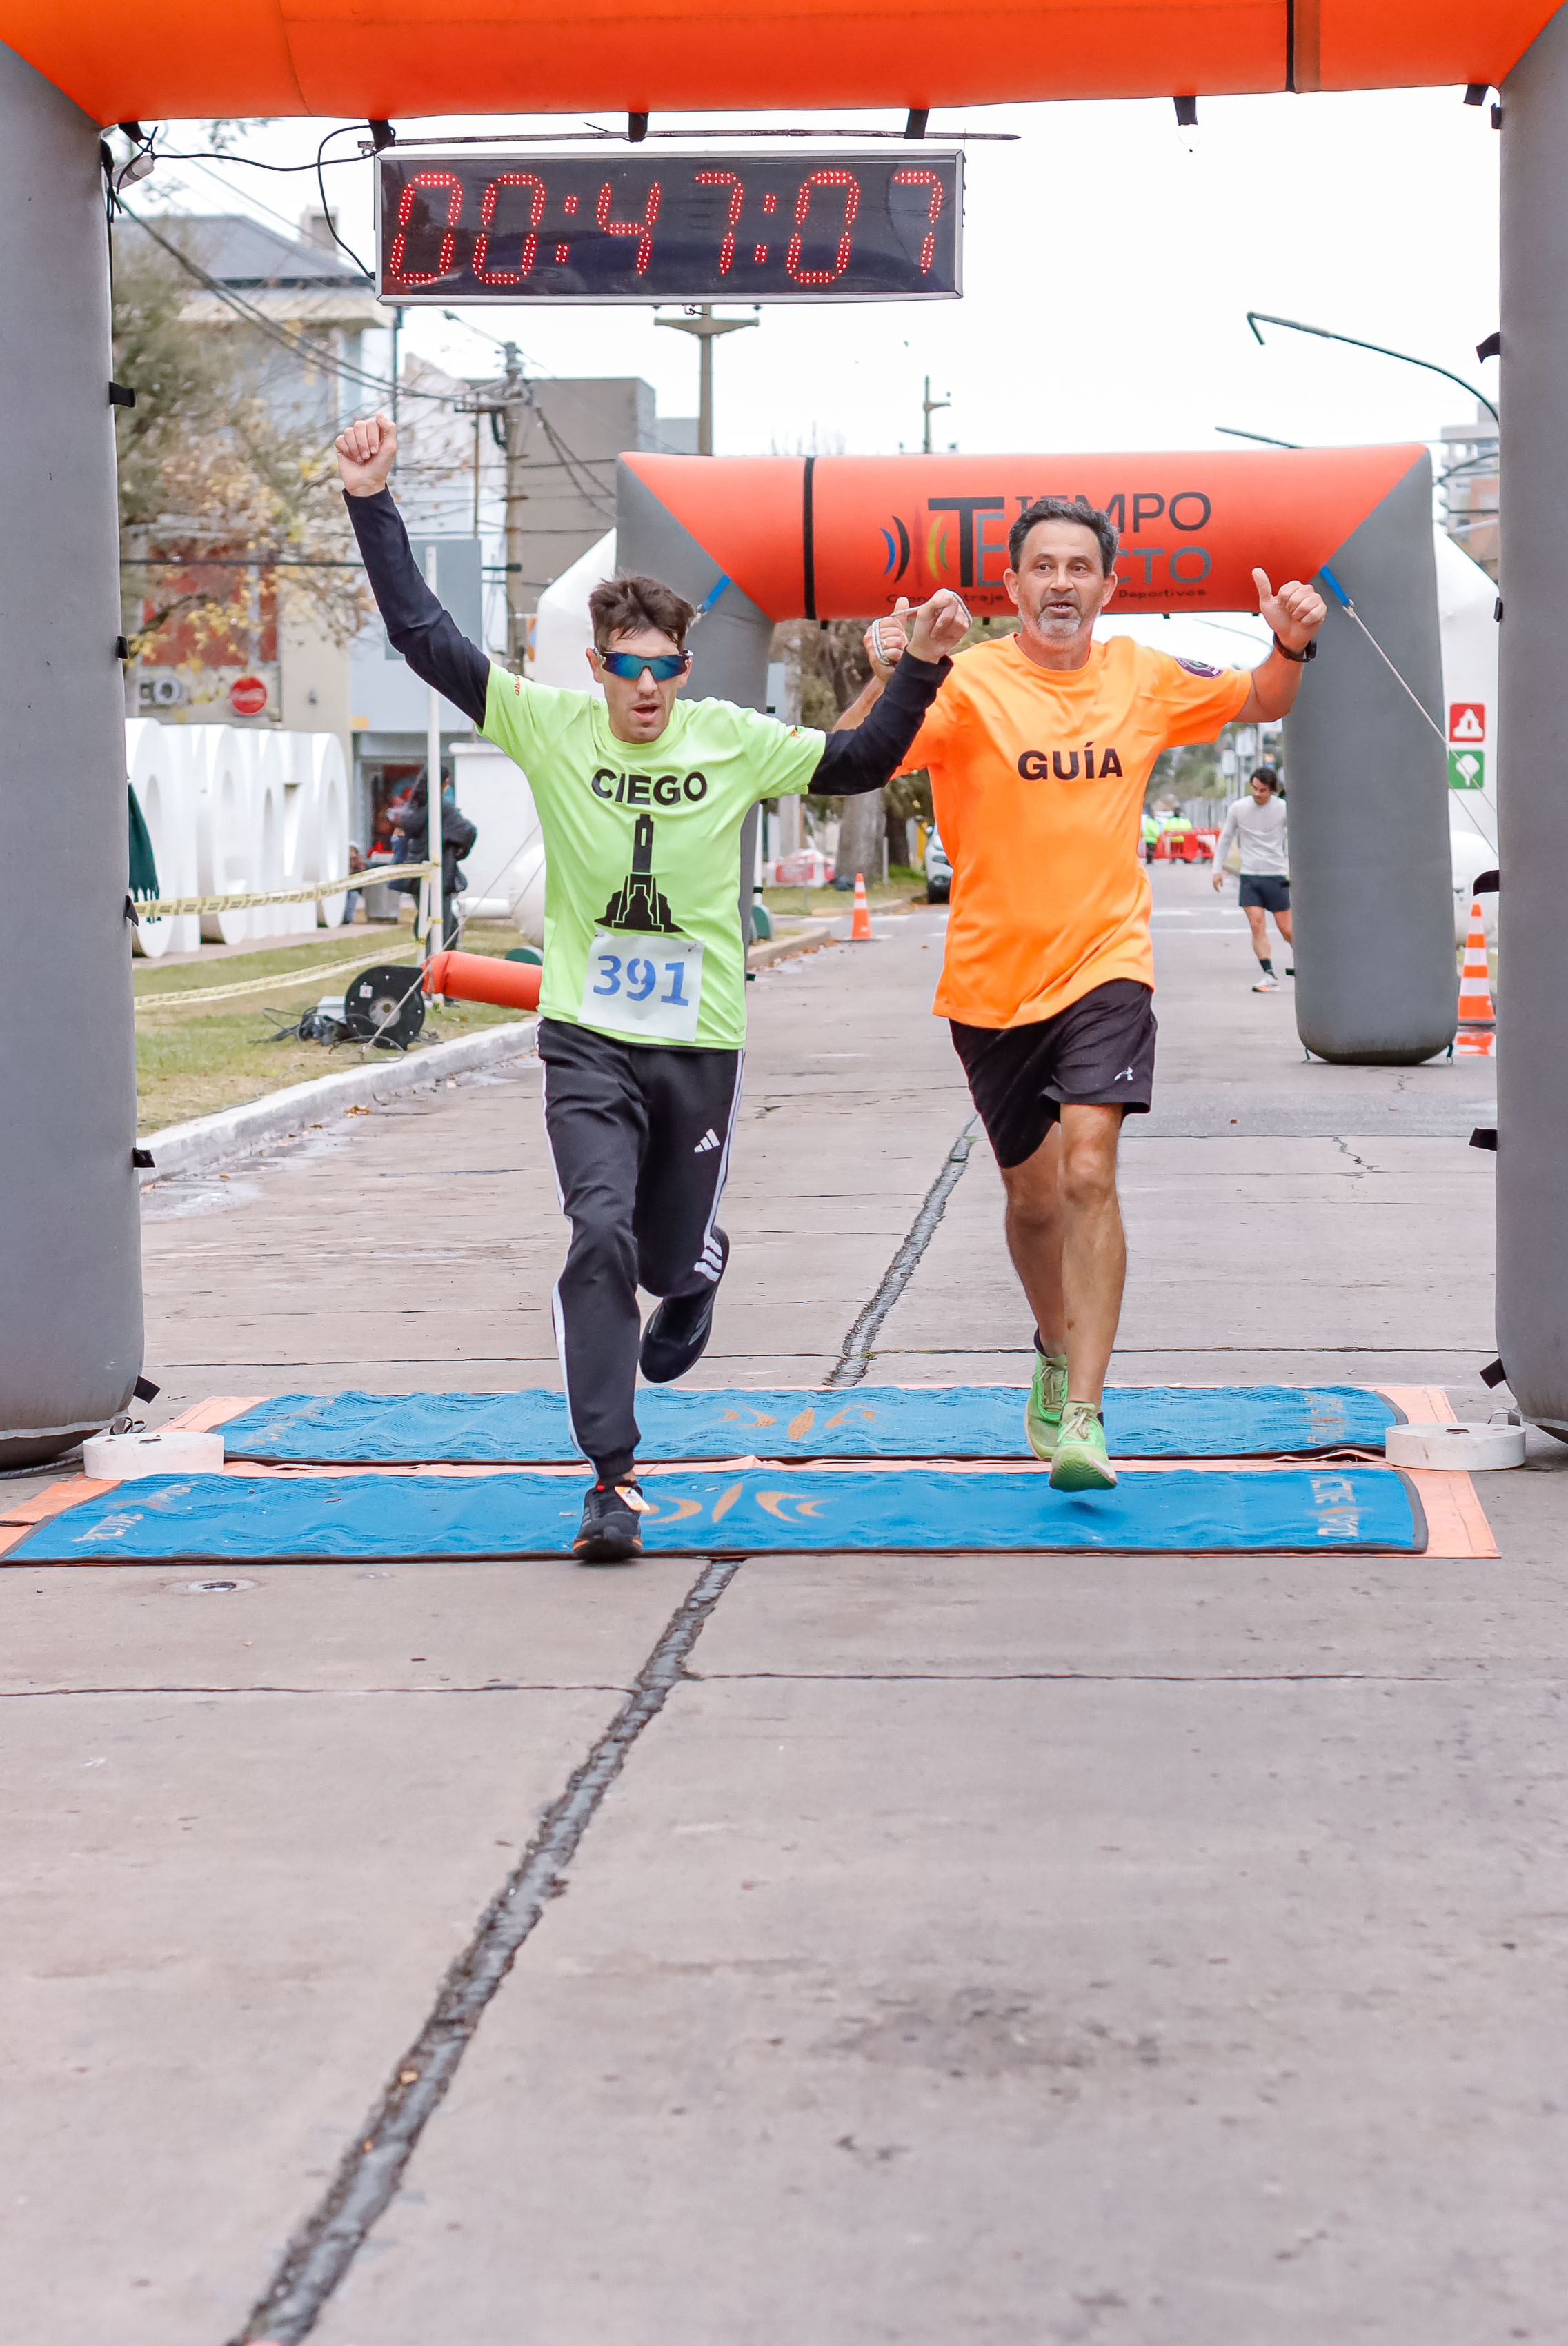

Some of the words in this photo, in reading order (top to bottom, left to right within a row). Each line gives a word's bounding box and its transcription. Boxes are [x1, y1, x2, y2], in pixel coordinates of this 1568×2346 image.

[390, 170, 943, 285] 00:47:07
[1118, 588, 1206, 599] Deportivos
[1018, 742, 1123, 780] GUÍA
[591, 768, 708, 805] CIEGO
[593, 954, 689, 1007] 391
